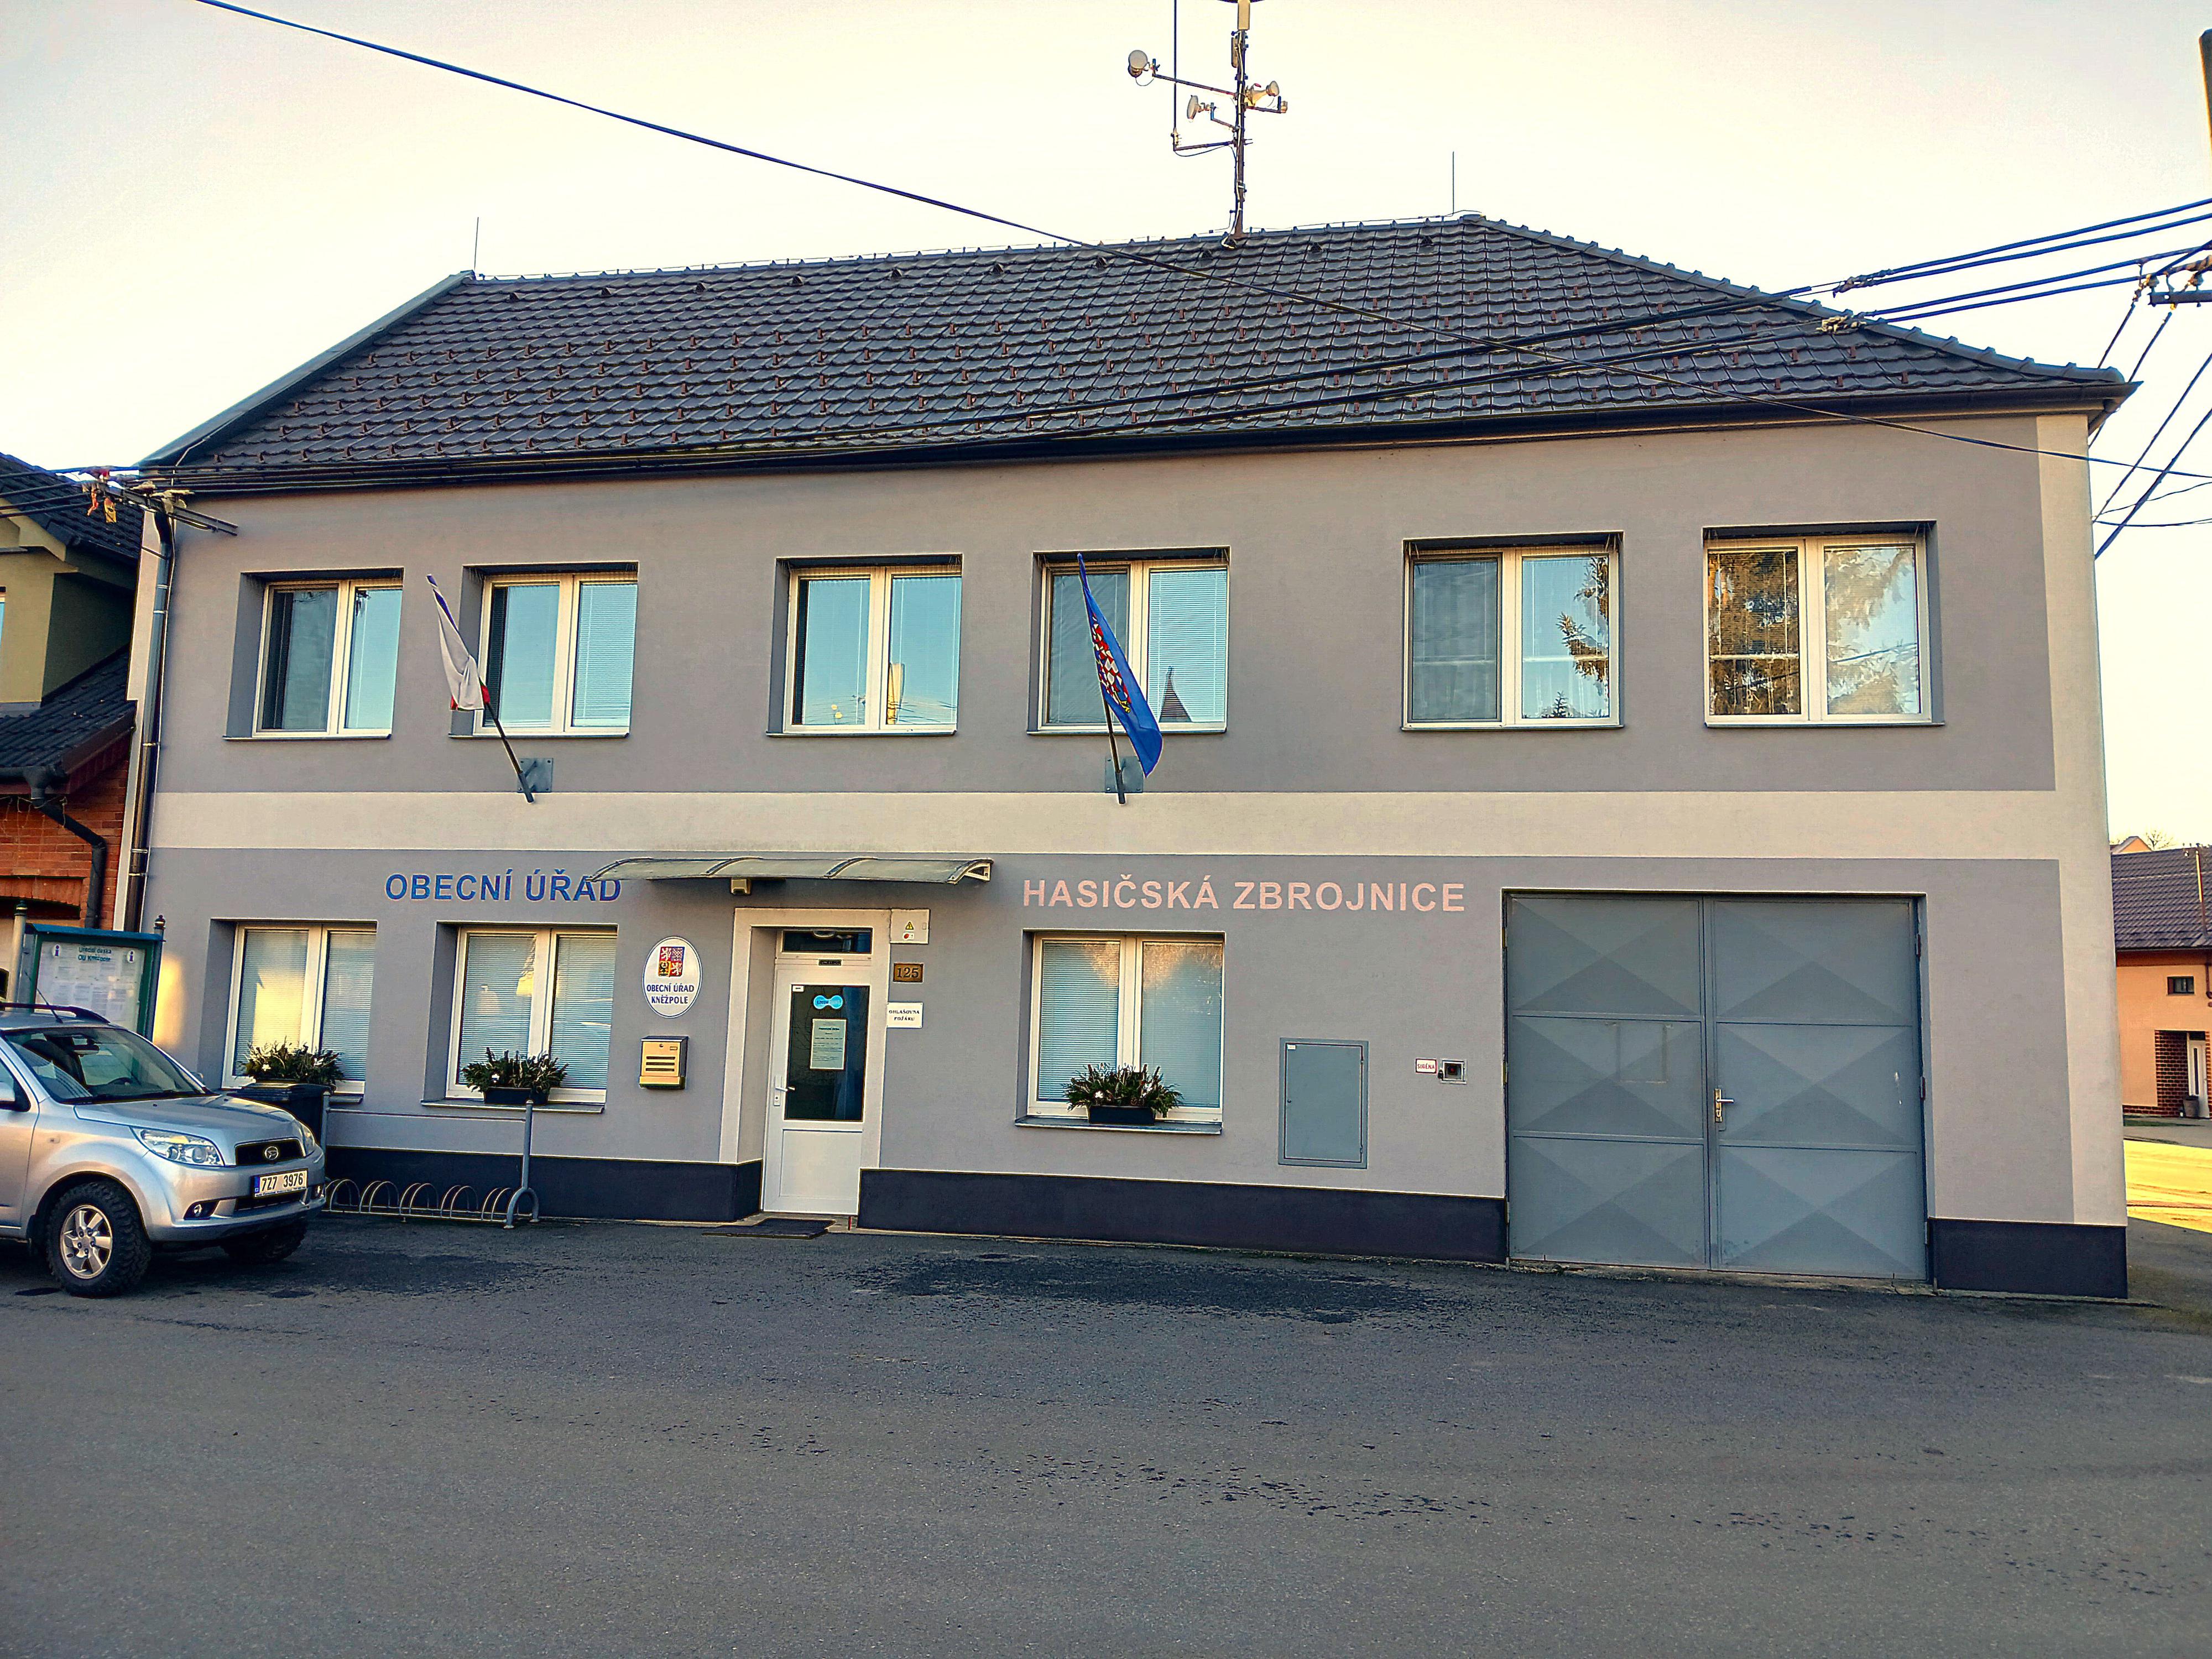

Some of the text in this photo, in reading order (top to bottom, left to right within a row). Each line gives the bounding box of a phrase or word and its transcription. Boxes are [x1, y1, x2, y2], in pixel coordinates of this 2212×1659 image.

[385, 868, 622, 902] OBECNÍ ÚŘAD
[1023, 874, 1465, 912] HASIČSKÁ ZBROJNICE
[896, 967, 919, 978] 125
[646, 983, 695, 992] OBECNÍ ÚŘAD
[651, 995, 688, 1004] KNĚŽPOLE
[262, 1172, 304, 1191] 7Z7 3976
